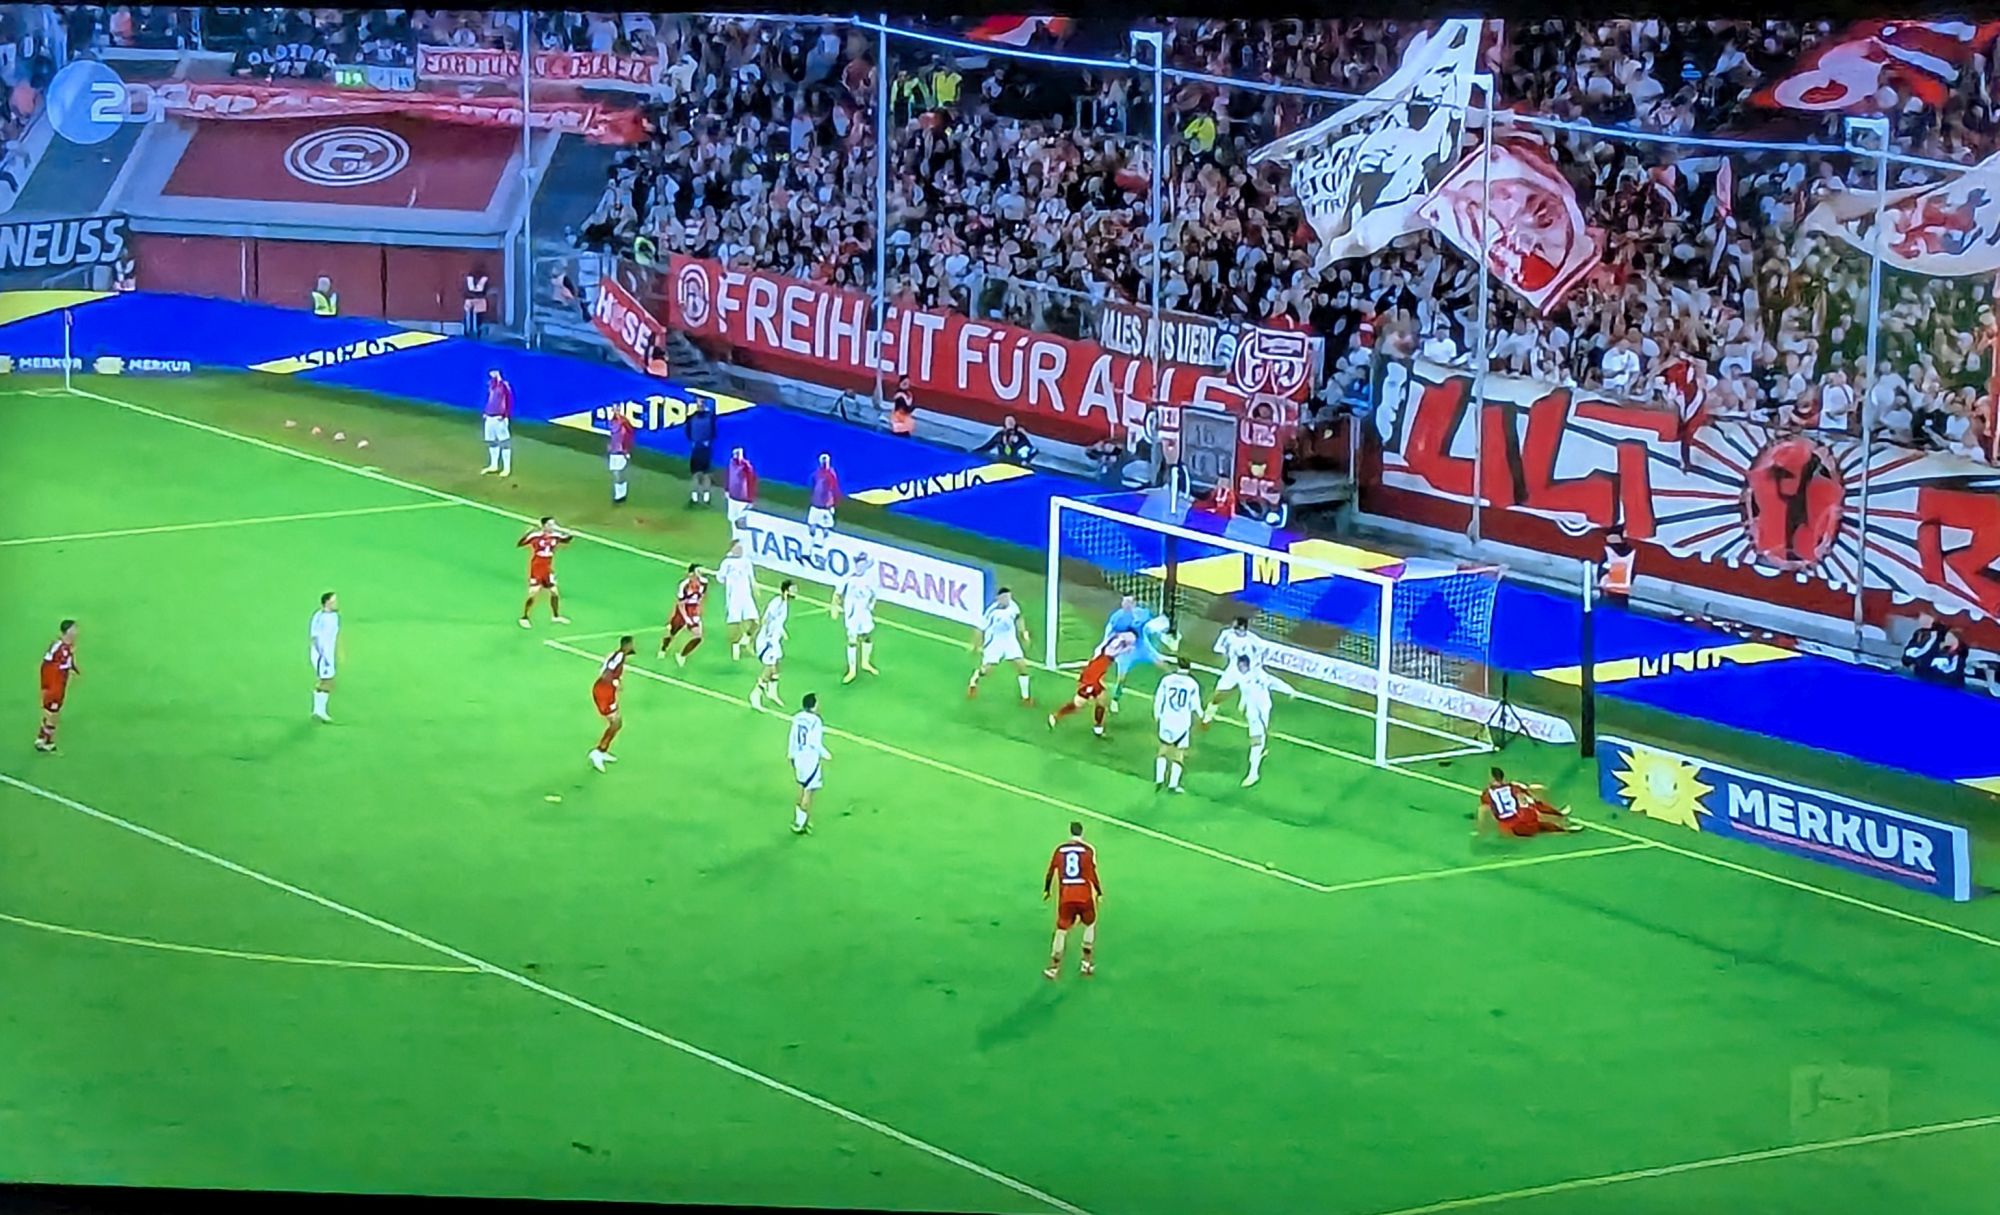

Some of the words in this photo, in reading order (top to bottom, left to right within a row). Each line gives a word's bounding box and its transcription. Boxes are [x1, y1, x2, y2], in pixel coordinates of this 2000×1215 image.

[0, 218, 125, 268] NEUSS
[129, 359, 192, 373] MERKUR
[717, 272, 946, 382] FREIHEIT
[957, 322, 1068, 413] FÜR
[750, 528, 850, 576] TARGO
[878, 560, 969, 611] BANK
[1168, 687, 1187, 712] 20
[1728, 782, 1936, 872] MERKUR
[1064, 850, 1081, 879] 8
